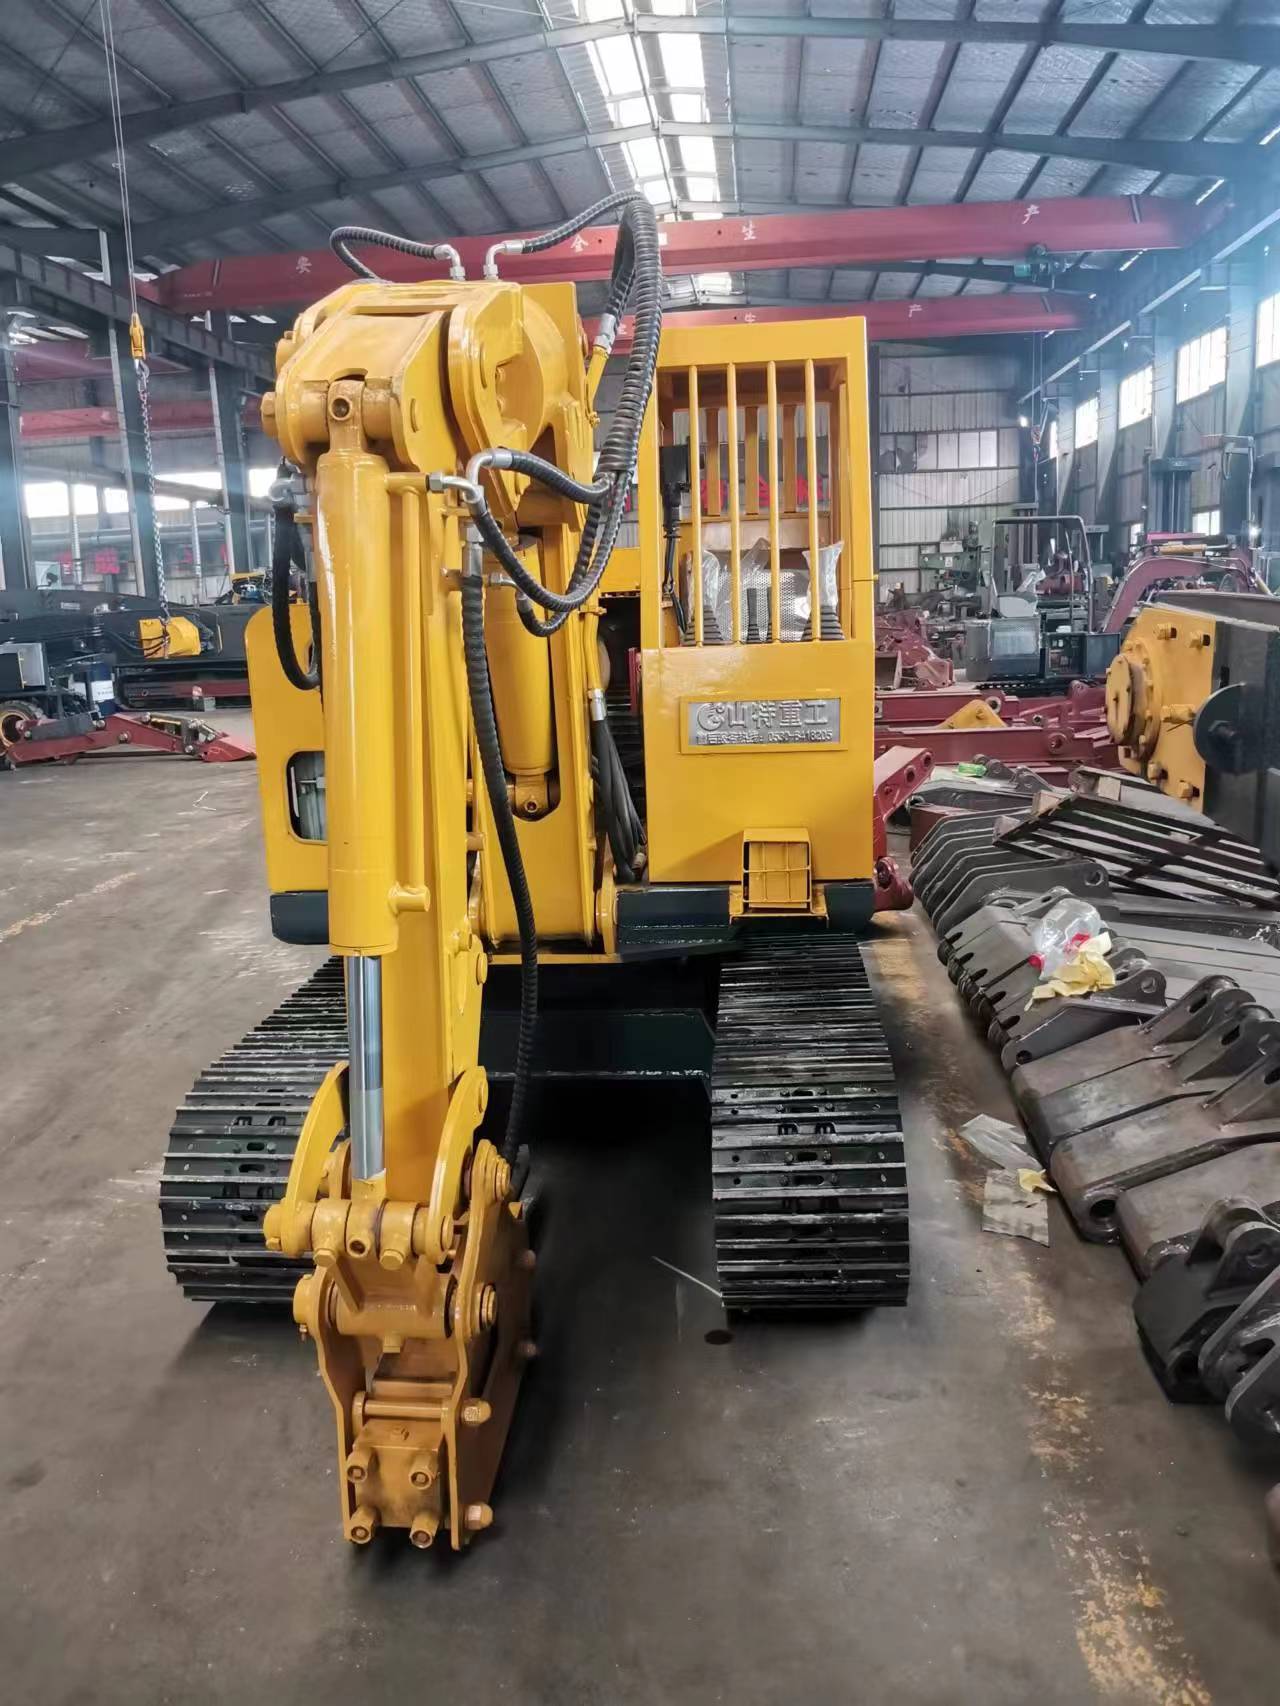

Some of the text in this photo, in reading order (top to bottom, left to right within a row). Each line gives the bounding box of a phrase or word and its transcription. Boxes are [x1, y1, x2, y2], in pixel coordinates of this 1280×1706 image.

[570, 233, 589, 253] 全
[742, 219, 757, 241] 生
[1022, 204, 1040, 225] 产
[727, 700, 829, 729] 山特重工
